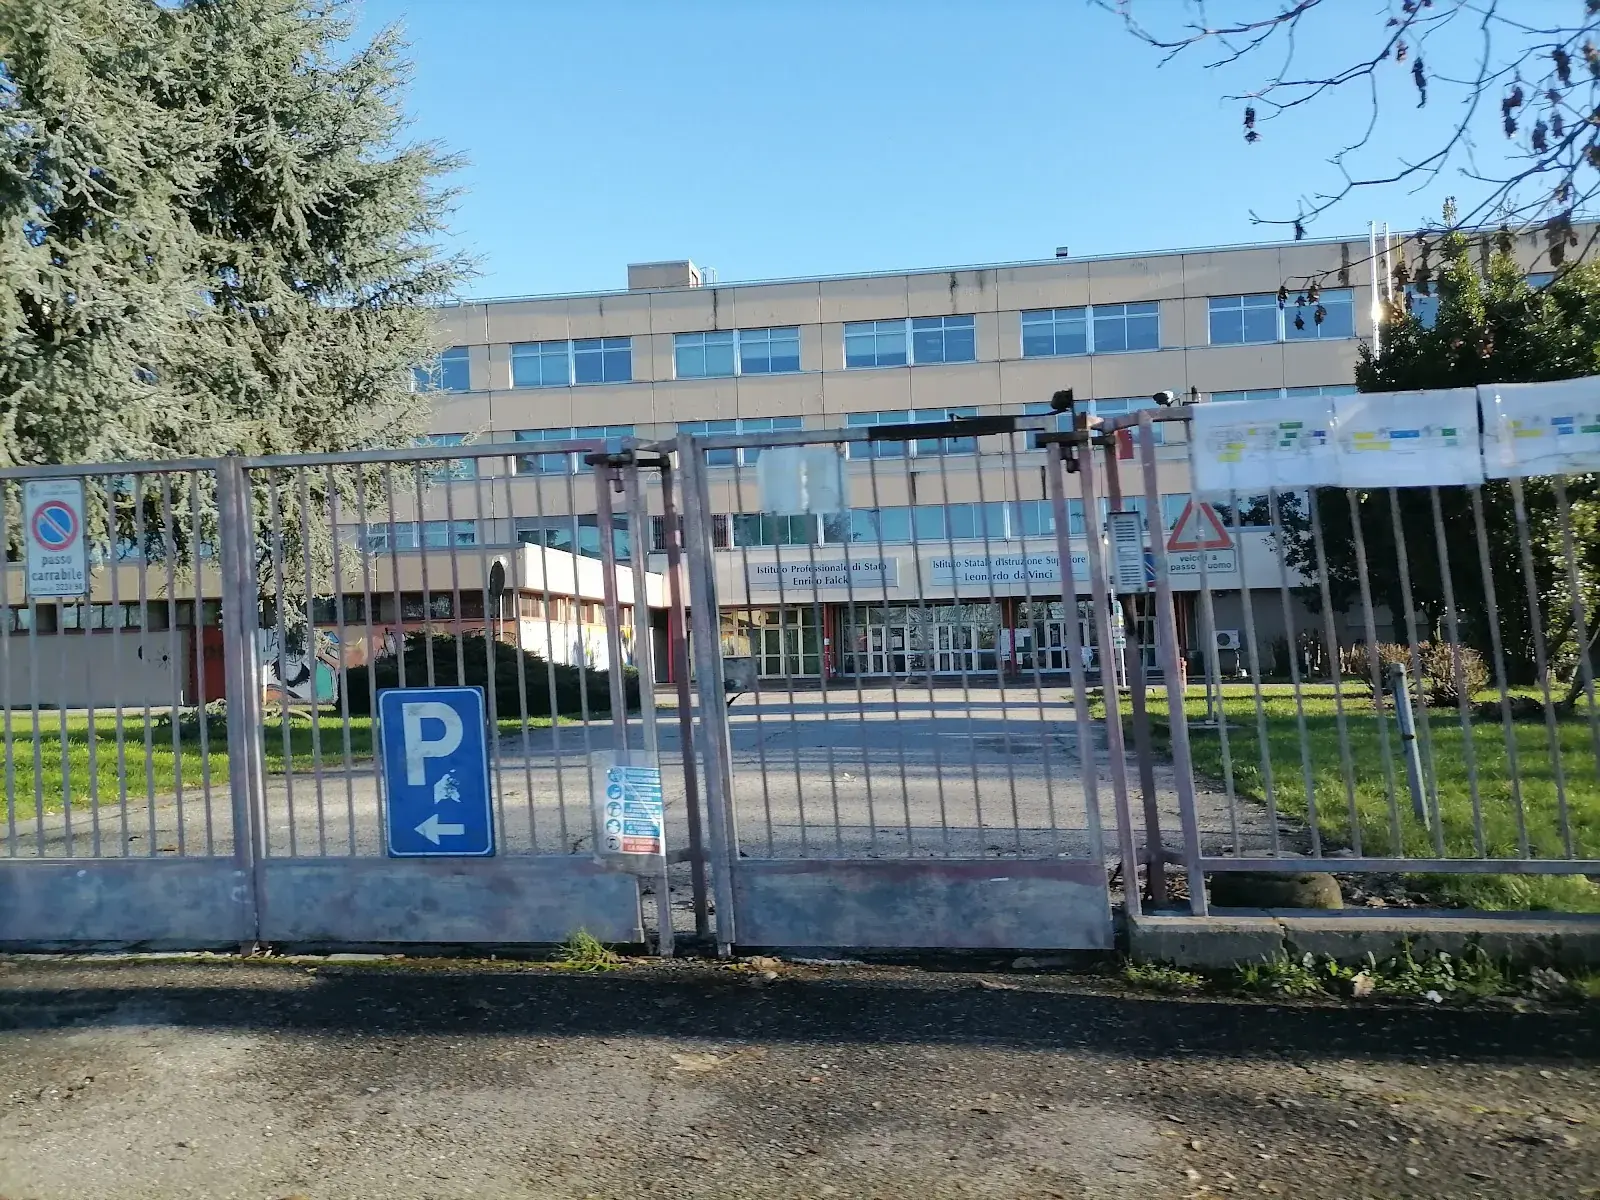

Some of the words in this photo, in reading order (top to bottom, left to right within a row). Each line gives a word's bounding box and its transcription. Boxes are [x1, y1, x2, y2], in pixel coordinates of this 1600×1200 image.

[41, 555, 73, 568] passo
[931, 559, 961, 569] Istituo
[1045, 555, 1086, 567] Supiore
[1180, 553, 1208, 562] veici
[757, 565, 788, 574] Istituo
[852, 562, 861, 571] di
[1170, 563, 1197, 571] passo
[32, 567, 83, 581] carrabile
[793, 576, 822, 586] Enrio
[825, 574, 849, 585] Falck
[964, 570, 1009, 581] Leonrdo
[1013, 570, 1026, 580] da
[1027, 568, 1053, 579] Vinci
[402, 702, 464, 786] P
